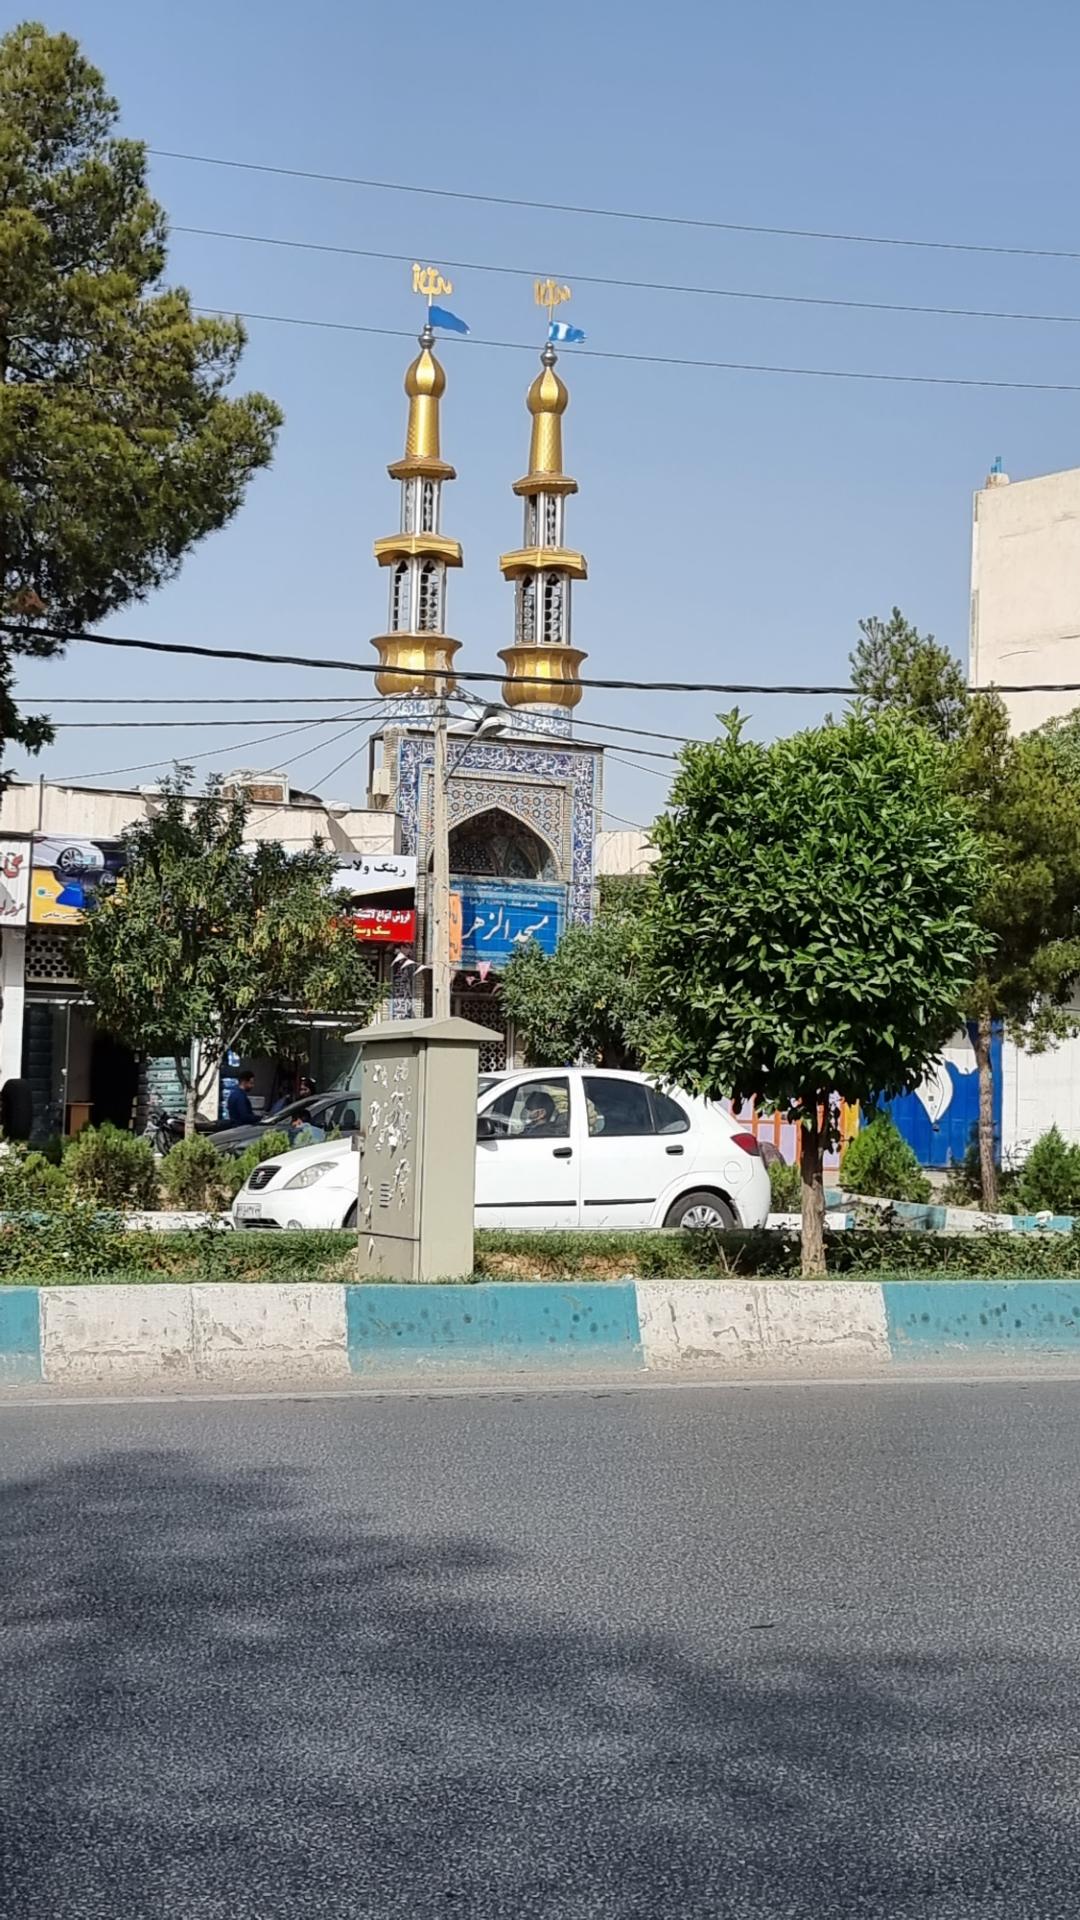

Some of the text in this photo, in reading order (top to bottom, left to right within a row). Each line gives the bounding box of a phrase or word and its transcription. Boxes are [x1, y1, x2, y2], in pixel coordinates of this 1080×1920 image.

[375, 909, 392, 923] انواع
[391, 909, 412, 925] فروش
[462, 906, 510, 941] الزهر
[509, 914, 550, 943] مسجد
